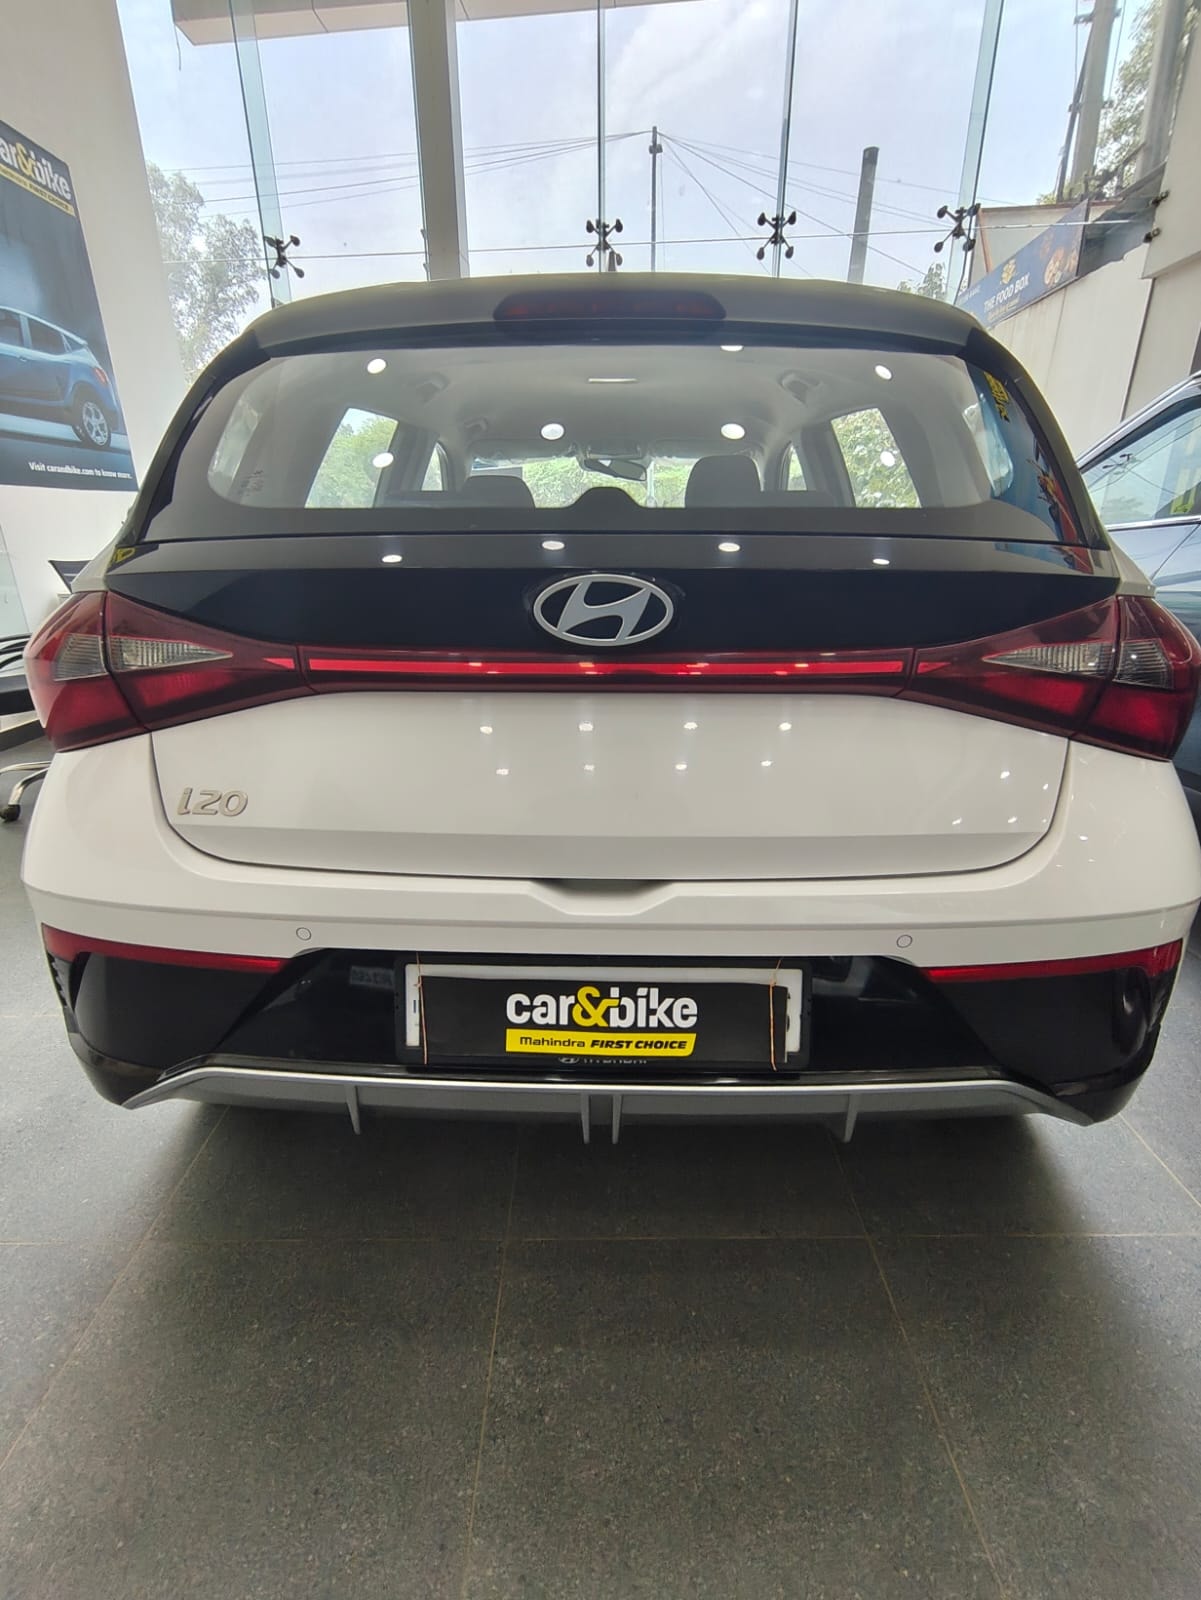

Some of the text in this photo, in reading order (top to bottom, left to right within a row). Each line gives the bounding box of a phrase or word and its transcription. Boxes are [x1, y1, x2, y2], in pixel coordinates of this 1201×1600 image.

[0, 137, 72, 200] ar&bike
[984, 296, 996, 312] THE
[995, 284, 1014, 304] FOOD
[1014, 272, 1030, 294] BOX
[29, 462, 46, 472] Visit
[47, 465, 94, 475] carandbike.com
[506, 986, 698, 1029] car&bike
[519, 1036, 688, 1050] Mahindra FIRST CHOICE
